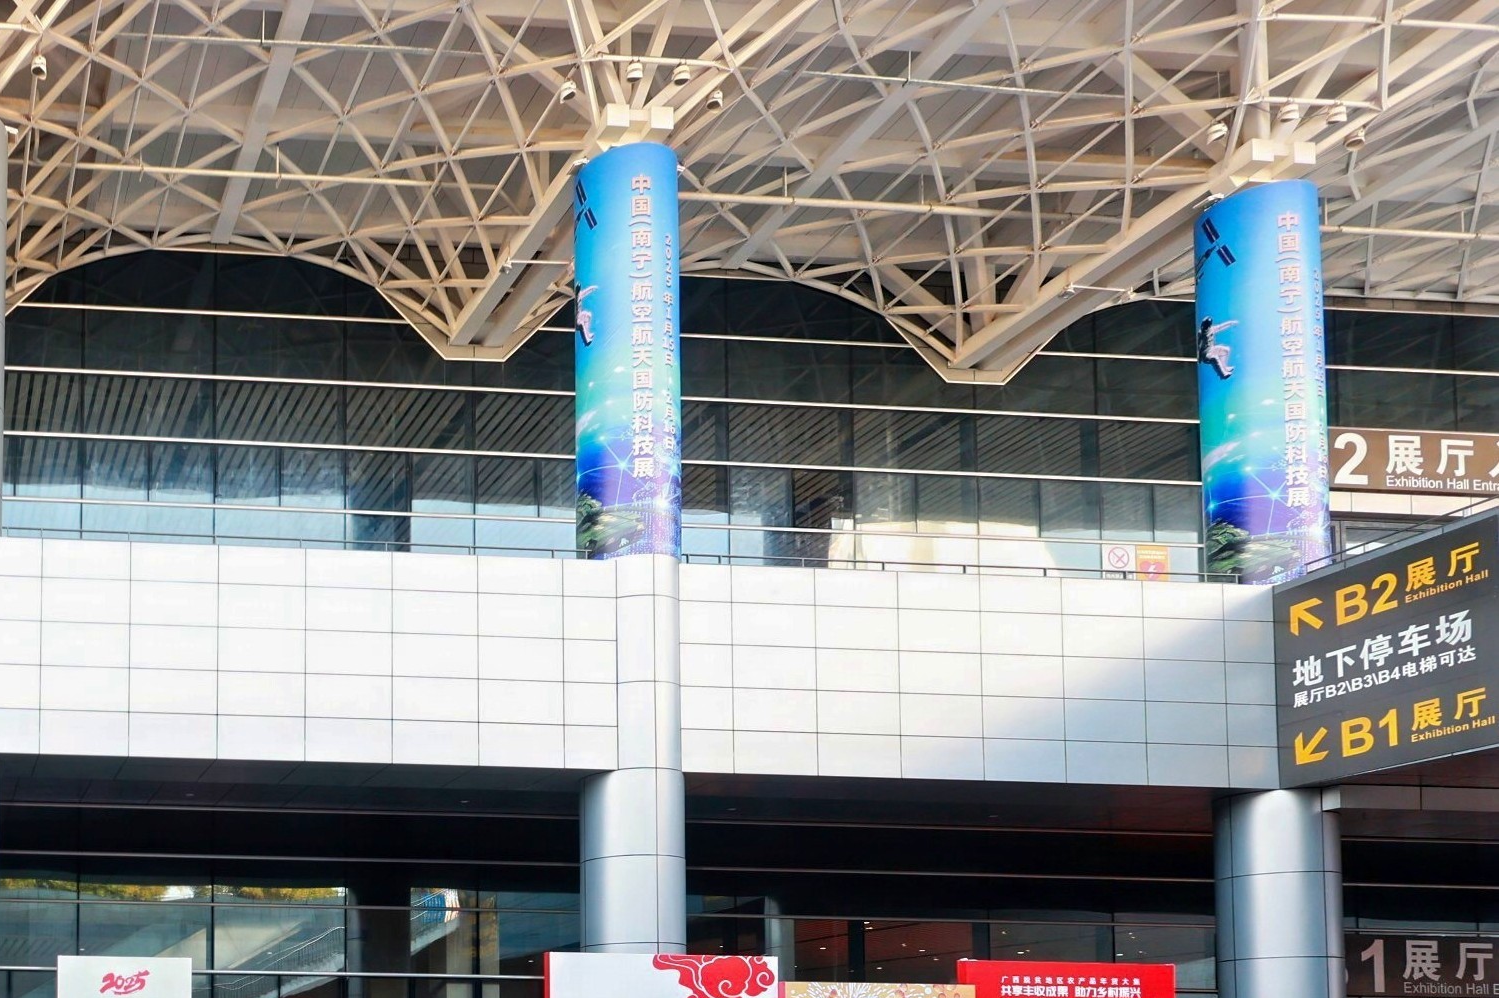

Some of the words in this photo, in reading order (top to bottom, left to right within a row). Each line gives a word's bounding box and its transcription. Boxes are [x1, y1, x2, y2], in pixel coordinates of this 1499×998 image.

[1386, 475, 1443, 488] Exhibition
[1447, 478, 1469, 490] Hall
[1335, 572, 1398, 626] B2
[1405, 541, 1480, 592] 展厅
[1405, 579, 1463, 604] Exhibition
[1465, 569, 1489, 584] Hall
[1292, 609, 1472, 687] 地下停车场
[1341, 708, 1398, 758] B1
[1411, 687, 1486, 731] 展厅
[1411, 723, 1469, 743] Exhibition
[1472, 715, 1496, 730] Hall
[1403, 939, 1494, 982] 展厅
[99, 969, 150, 995] 2025
[1000, 985, 1069, 998] 共享丰收成果
[1075, 987, 1142, 998] 助力乡村振兴
[1403, 982, 1462, 995] Exhibition
[1466, 983, 1489, 995] Hall
